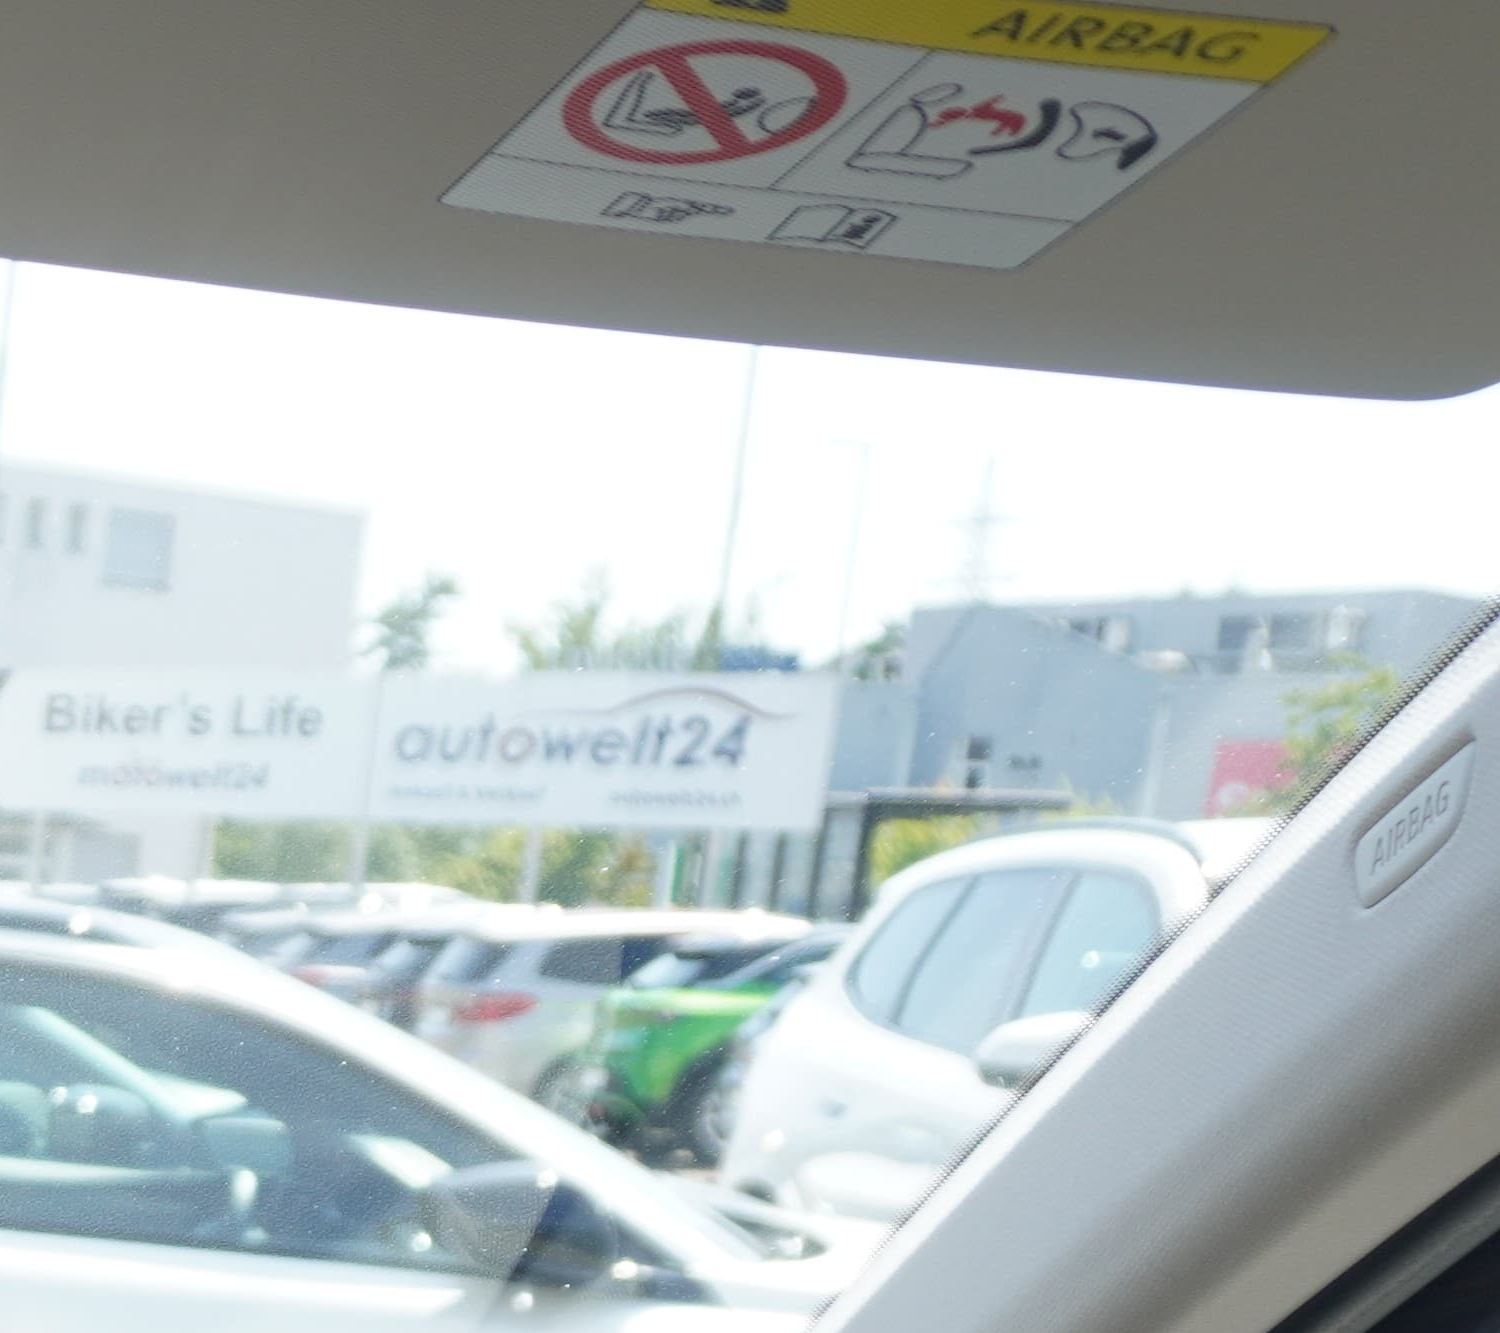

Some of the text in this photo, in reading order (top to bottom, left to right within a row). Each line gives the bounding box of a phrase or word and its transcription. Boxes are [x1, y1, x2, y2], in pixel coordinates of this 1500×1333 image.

[970, 8, 1263, 63] AIRBAG
[42, 692, 326, 739] Biker's Life
[395, 711, 752, 768] autowelt24
[1367, 779, 1451, 877] AIRBAG
